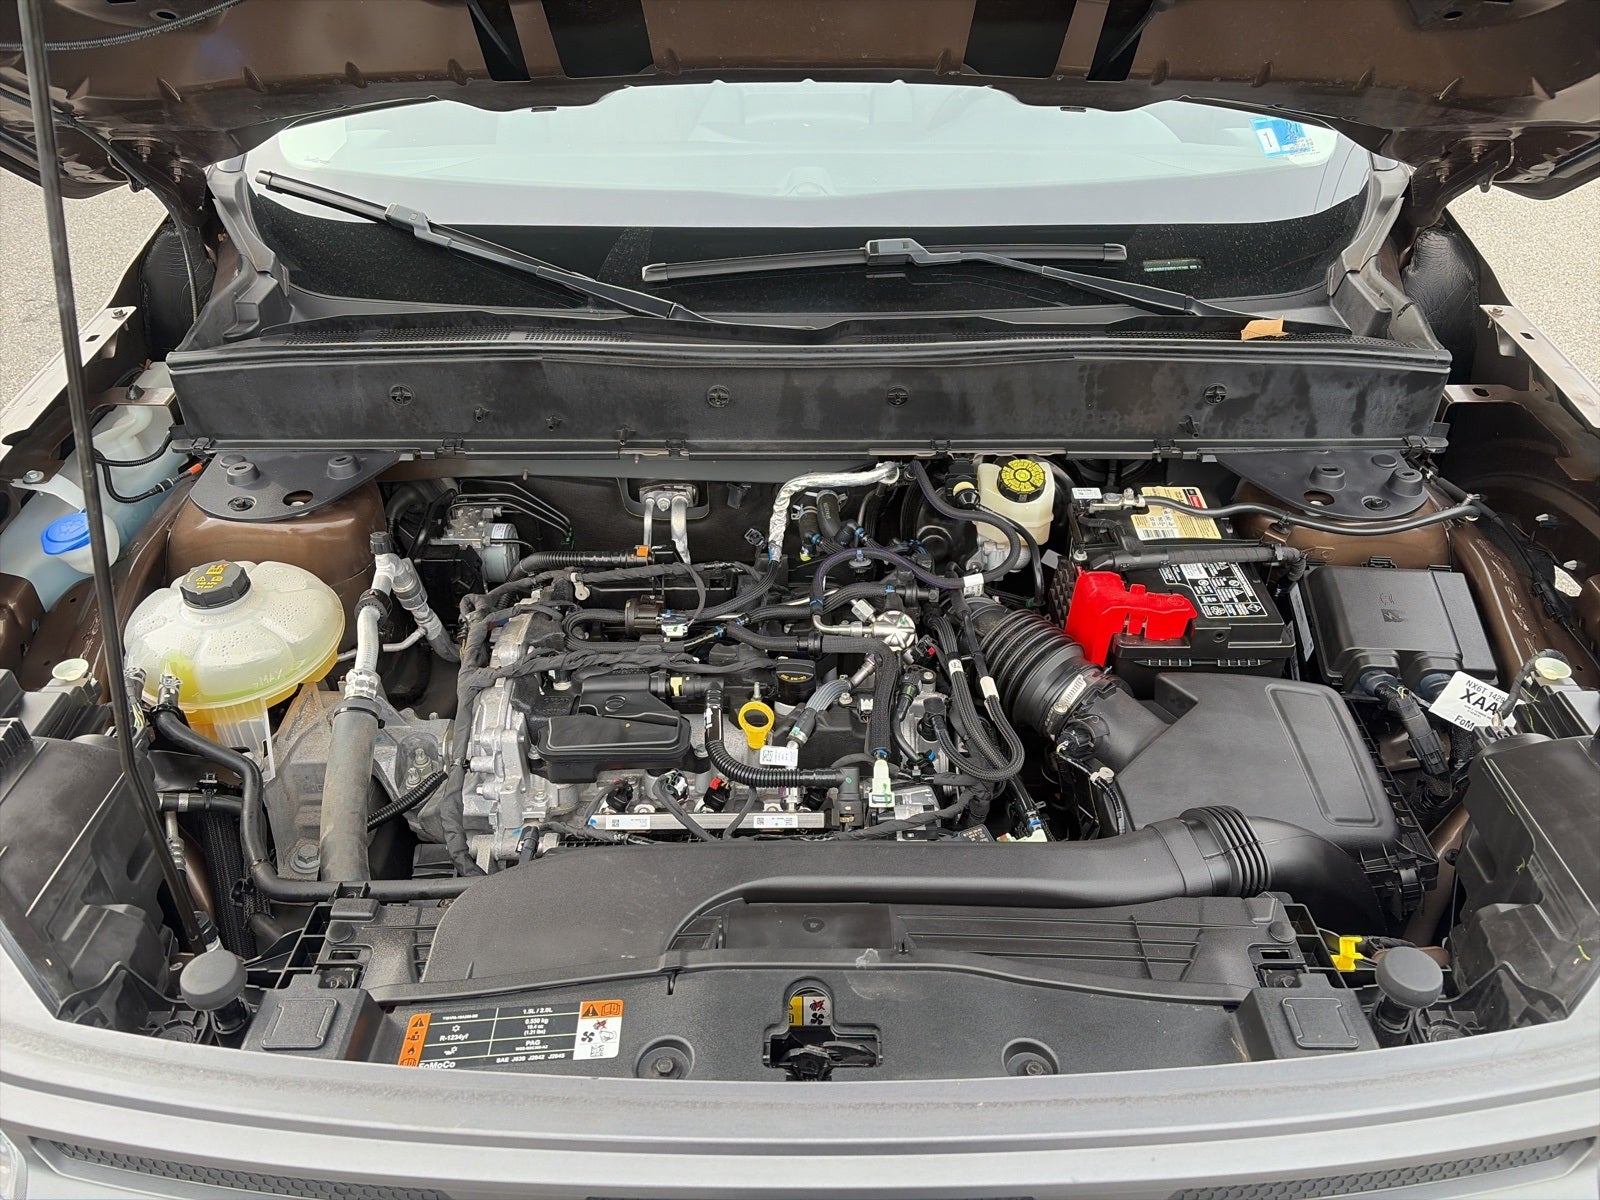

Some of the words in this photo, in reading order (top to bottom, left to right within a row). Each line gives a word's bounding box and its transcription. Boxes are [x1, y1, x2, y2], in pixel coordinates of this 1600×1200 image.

[1465, 679, 1488, 695] NX6T
[1460, 687, 1499, 716] XAA
[439, 1033, 469, 1042] R-1234yf
[525, 1039, 541, 1047] PAG
[418, 1060, 456, 1069] FoMoCo
